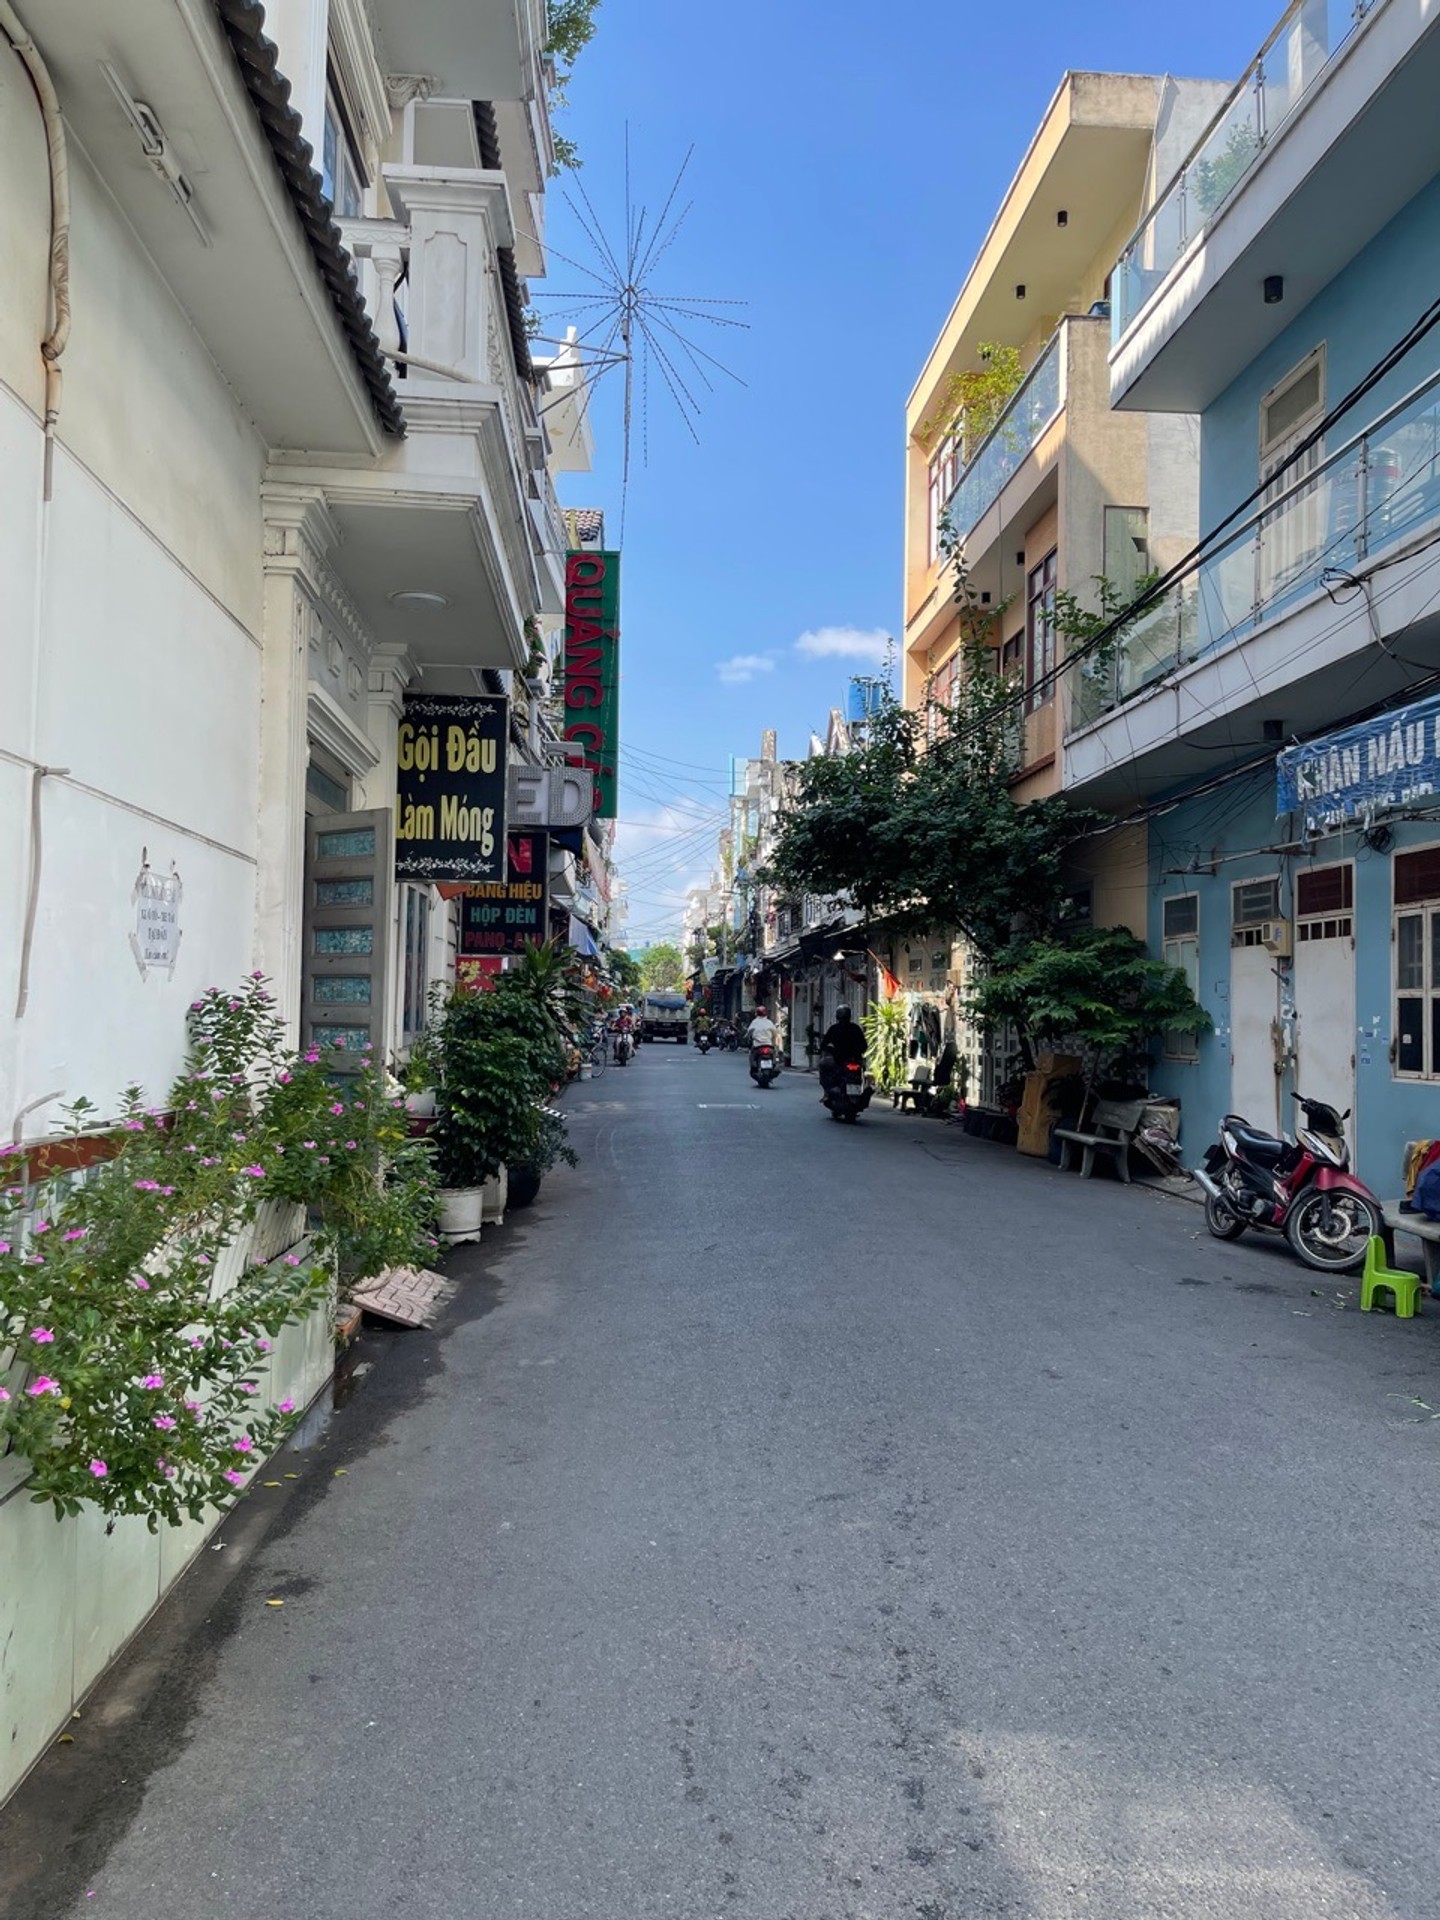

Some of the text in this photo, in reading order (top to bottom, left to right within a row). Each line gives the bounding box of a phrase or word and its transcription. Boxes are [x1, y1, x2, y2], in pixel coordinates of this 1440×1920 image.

[565, 553, 620, 710] QUẢNG
[398, 719, 497, 783] Gội Đầu
[396, 793, 494, 857] Làm Móng
[470, 903, 537, 927] HỘP ĐÈN
[508, 880, 543, 902] HIỆU
